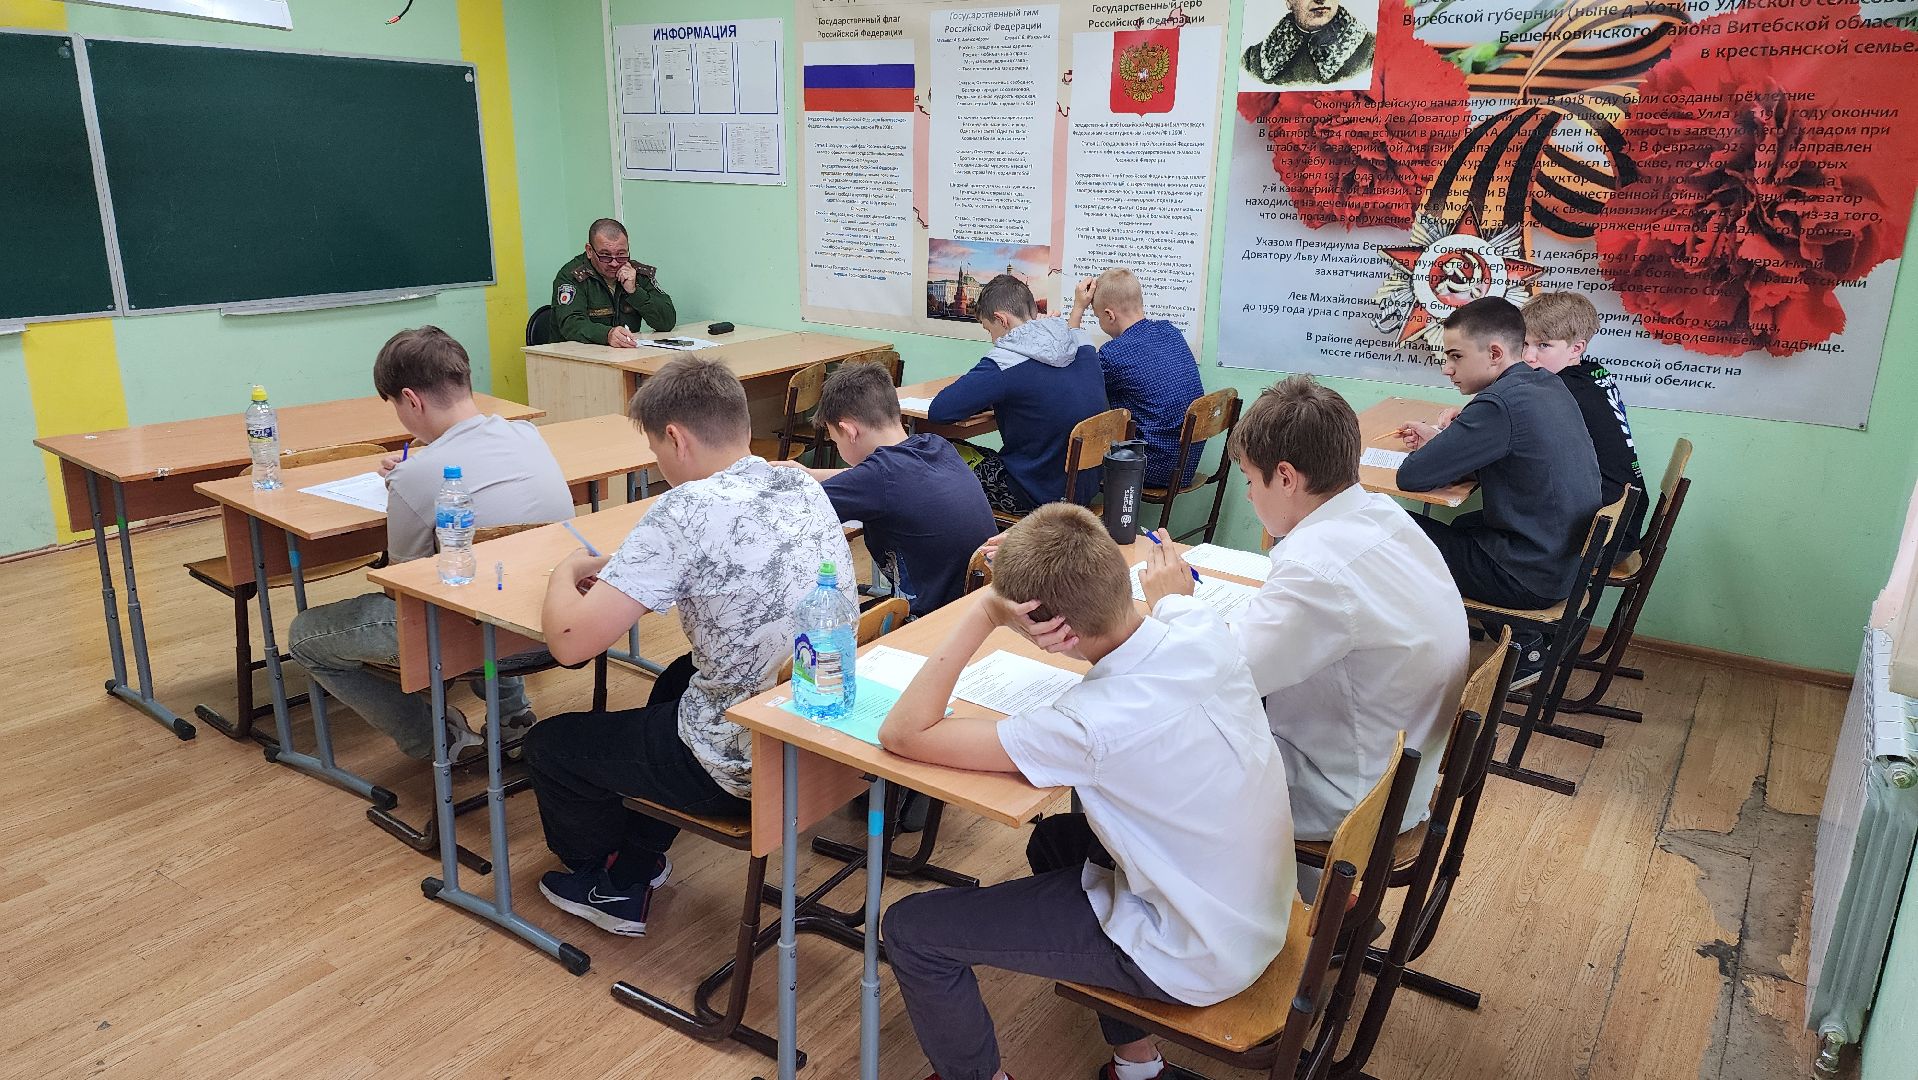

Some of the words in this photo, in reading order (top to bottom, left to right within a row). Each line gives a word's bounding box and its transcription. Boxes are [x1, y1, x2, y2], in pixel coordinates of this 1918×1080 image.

[950, 9, 1021, 21] Государственный
[1092, 1, 1177, 14] Государственный
[1403, 9, 1483, 26] Витебской
[1487, 7, 1564, 24] губернии
[1567, 4, 1618, 21] (ныне
[1641, 1, 1710, 13] Хотино
[818, 14, 881, 26] Государственный
[882, 15, 901, 24] флаг
[944, 23, 991, 33] Российской
[994, 22, 1042, 32] Федерации
[1088, 17, 1145, 28] Российской
[1147, 15, 1205, 25] Федерации
[653, 25, 737, 40] ИНФОРМАЦИЯ
[817, 29, 859, 39] Российской
[860, 29, 903, 38] Федерации
[1500, 26, 1651, 43] Бешенковичского
[1727, 15, 1829, 33] Витебской
[1836, 14, 1917, 29] области
[1700, 48, 1710, 58] в
[1716, 40, 1849, 62] крестьянской
[1314, 99, 1361, 109] Окончил
[1364, 96, 1427, 110] еврейскую
[1431, 95, 1496, 109] начальную
[1499, 95, 1543, 108] школу.
[1547, 95, 1557, 105] В
[1558, 94, 1585, 106] 1918
[1589, 95, 1618, 108] году
[1622, 92, 1658, 105] были
[1662, 93, 1723, 106] созданы
[1256, 115, 1292, 124] школы
[1294, 113, 1333, 125] второй
[1384, 114, 1407, 124] Лев
[1408, 113, 1460, 126] Доватор
[1576, 111, 1620, 123] школу
[1624, 111, 1631, 121] в
[1635, 108, 1694, 120] посёлке
[1696, 108, 1730, 119] Улла
[1832, 108, 1899, 118] окончил
[1258, 129, 1266, 138] В
[1344, 130, 1370, 140] года
[1420, 130, 1428, 138] в
[1430, 129, 1461, 140] ряды
[1585, 127, 1601, 137] на
[1860, 125, 1891, 138] при
[1639, 142, 1649, 152] В
[1788, 142, 1872, 156] направлен
[1603, 160, 1611, 168] в
[1675, 160, 1693, 168] по
[1421, 174, 1434, 182] на
[1262, 183, 1277, 193] 7-й
[1415, 188, 1423, 196] В
[1245, 198, 1298, 209] находился
[1316, 200, 1361, 209] лечении
[1364, 201, 1370, 209] в
[1552, 205, 1559, 213] к
[1600, 206, 1658, 217] дивизии
[1660, 207, 1678, 216] не
[1801, 210, 1840, 221] из-за
[1843, 211, 1884, 224] того,
[1259, 212, 1277, 220] что
[1279, 212, 1298, 221] она
[1349, 216, 1413, 226] окружение.
[1663, 222, 1708, 233] штаба
[1255, 236, 1293, 247] Указом
[1295, 238, 1360, 251] Президиума
[1433, 244, 1474, 255] Совета
[1477, 245, 1509, 256] СССР
[1529, 249, 1541, 258] 21
[1543, 248, 1599, 261] декабря
[1601, 252, 1628, 263] 1941
[1241, 249, 1292, 262] Доватору
[1294, 251, 1319, 264] Льву
[1321, 253, 1395, 268] Михайловичу
[1398, 258, 1410, 267] за
[1413, 259, 1470, 270] мужество
[1541, 264, 1631, 277] проявленные
[1315, 268, 1393, 280] захватчиками,
[1529, 279, 1574, 289] звание
[1576, 280, 1615, 292] Героя
[1288, 291, 1307, 302] Лев
[1309, 293, 1377, 306] Михайлович
[1430, 300, 1452, 311] был
[1242, 303, 1256, 313] до
[1258, 303, 1280, 315] 1959
[1282, 305, 1305, 315] года
[1307, 306, 1332, 317] урна
[1342, 310, 1383, 321] прахом
[1425, 314, 1432, 323] в
[1631, 313, 1700, 327] Донского
[1306, 332, 1313, 341] В
[1315, 334, 1353, 345] районе
[1355, 337, 1401, 350] деревни
[1635, 329, 1651, 339] на
[1320, 348, 1352, 358] месте
[1353, 350, 1392, 362] гибели
[1393, 353, 1405, 363] Л.
[1408, 354, 1422, 364] М.
[1664, 361, 1722, 375] области
[1724, 366, 1742, 376] на
[1654, 374, 1716, 389] обелиск.
